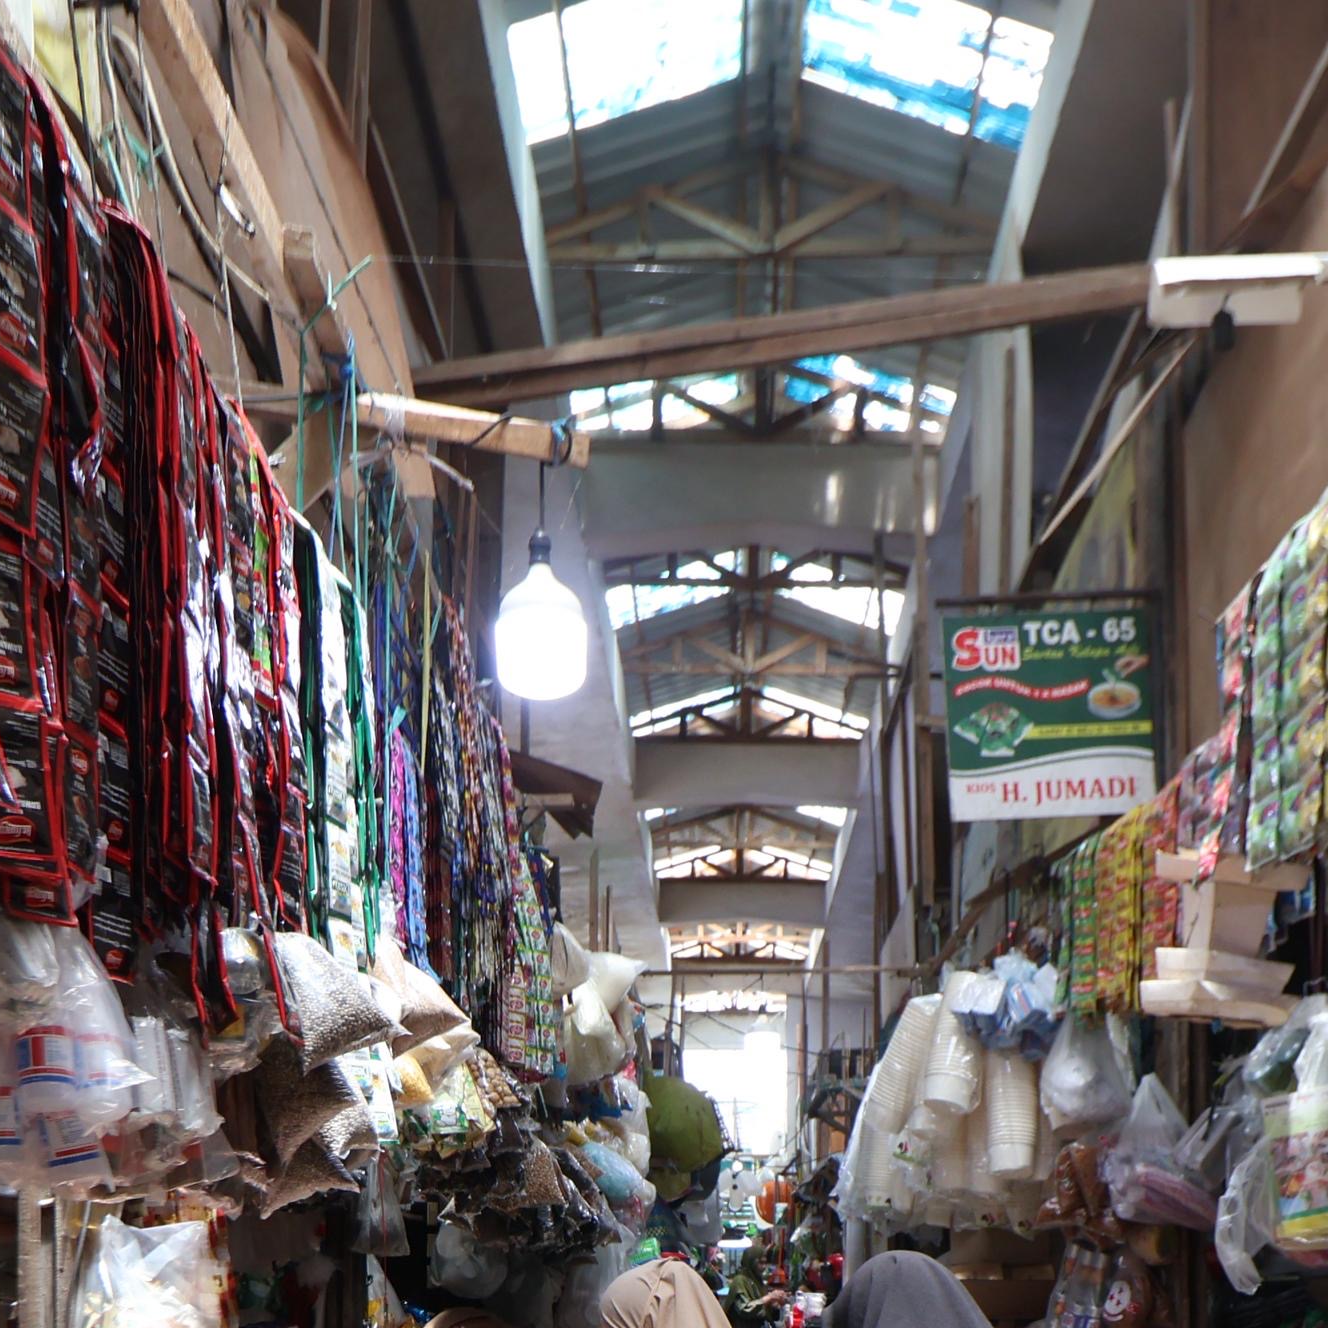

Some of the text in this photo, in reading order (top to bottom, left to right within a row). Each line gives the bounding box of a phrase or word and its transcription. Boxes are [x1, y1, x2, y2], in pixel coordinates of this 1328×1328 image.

[1023, 618, 1081, 645] TCA
[1086, 627, 1097, 638] -
[1102, 616, 1137, 643] 65
[953, 627, 1017, 670] SUN
[1001, 782, 1029, 803] H.
[1034, 775, 1138, 806] JUMADI
